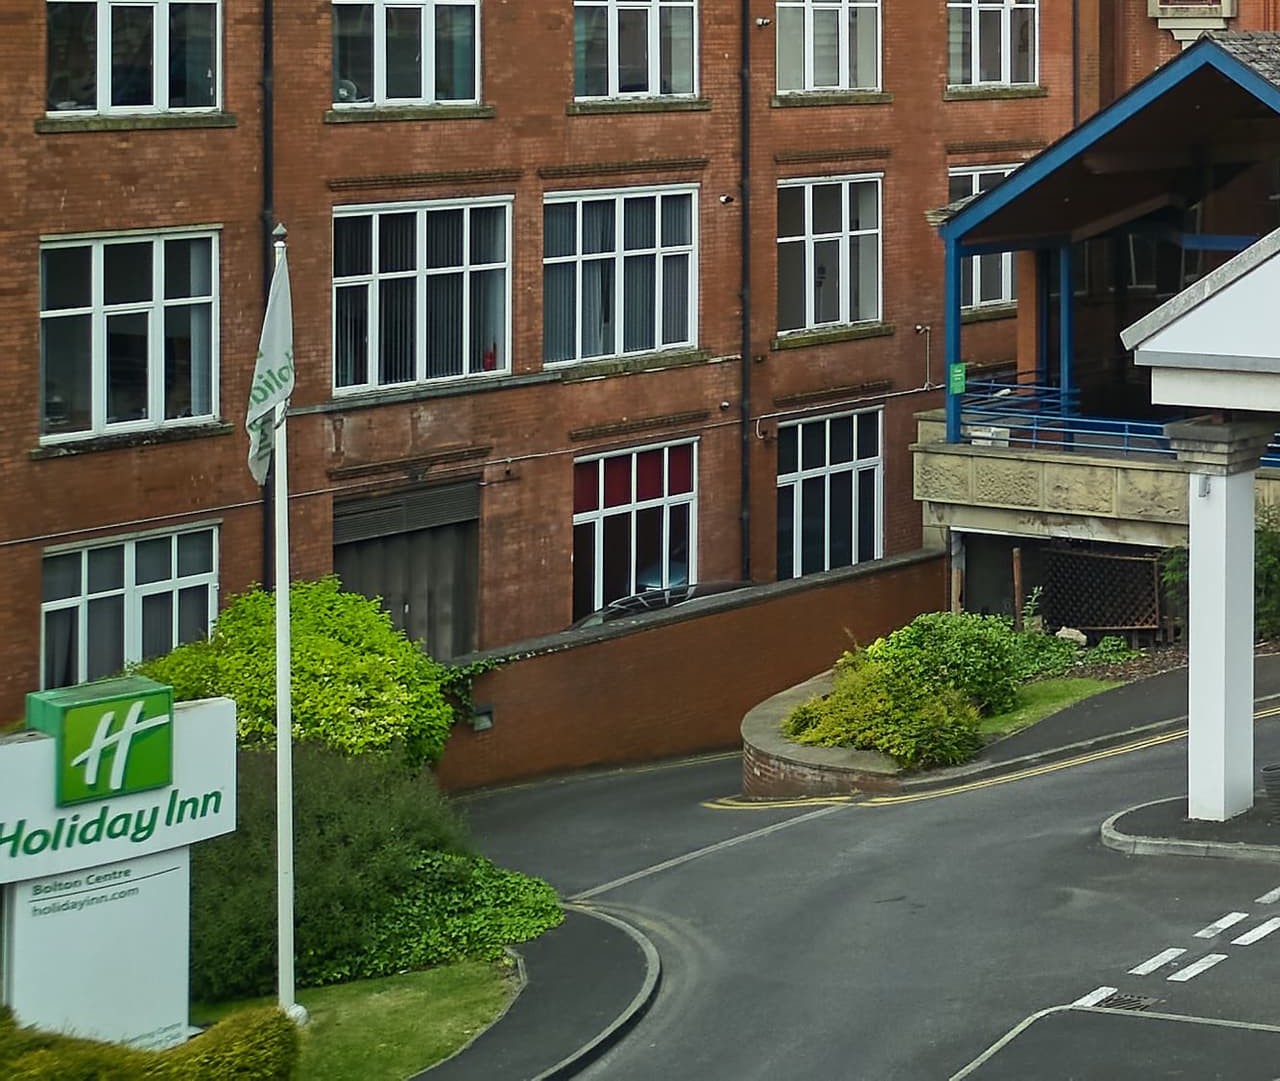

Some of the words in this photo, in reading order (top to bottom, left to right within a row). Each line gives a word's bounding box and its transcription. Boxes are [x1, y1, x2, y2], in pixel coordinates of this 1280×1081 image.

[0, 806, 159, 858] Holiday
[165, 789, 222, 826] Inn
[32, 879, 82, 896] Bolton
[86, 869, 131, 886] Centre
[31, 886, 139, 917] holidayinn.com
